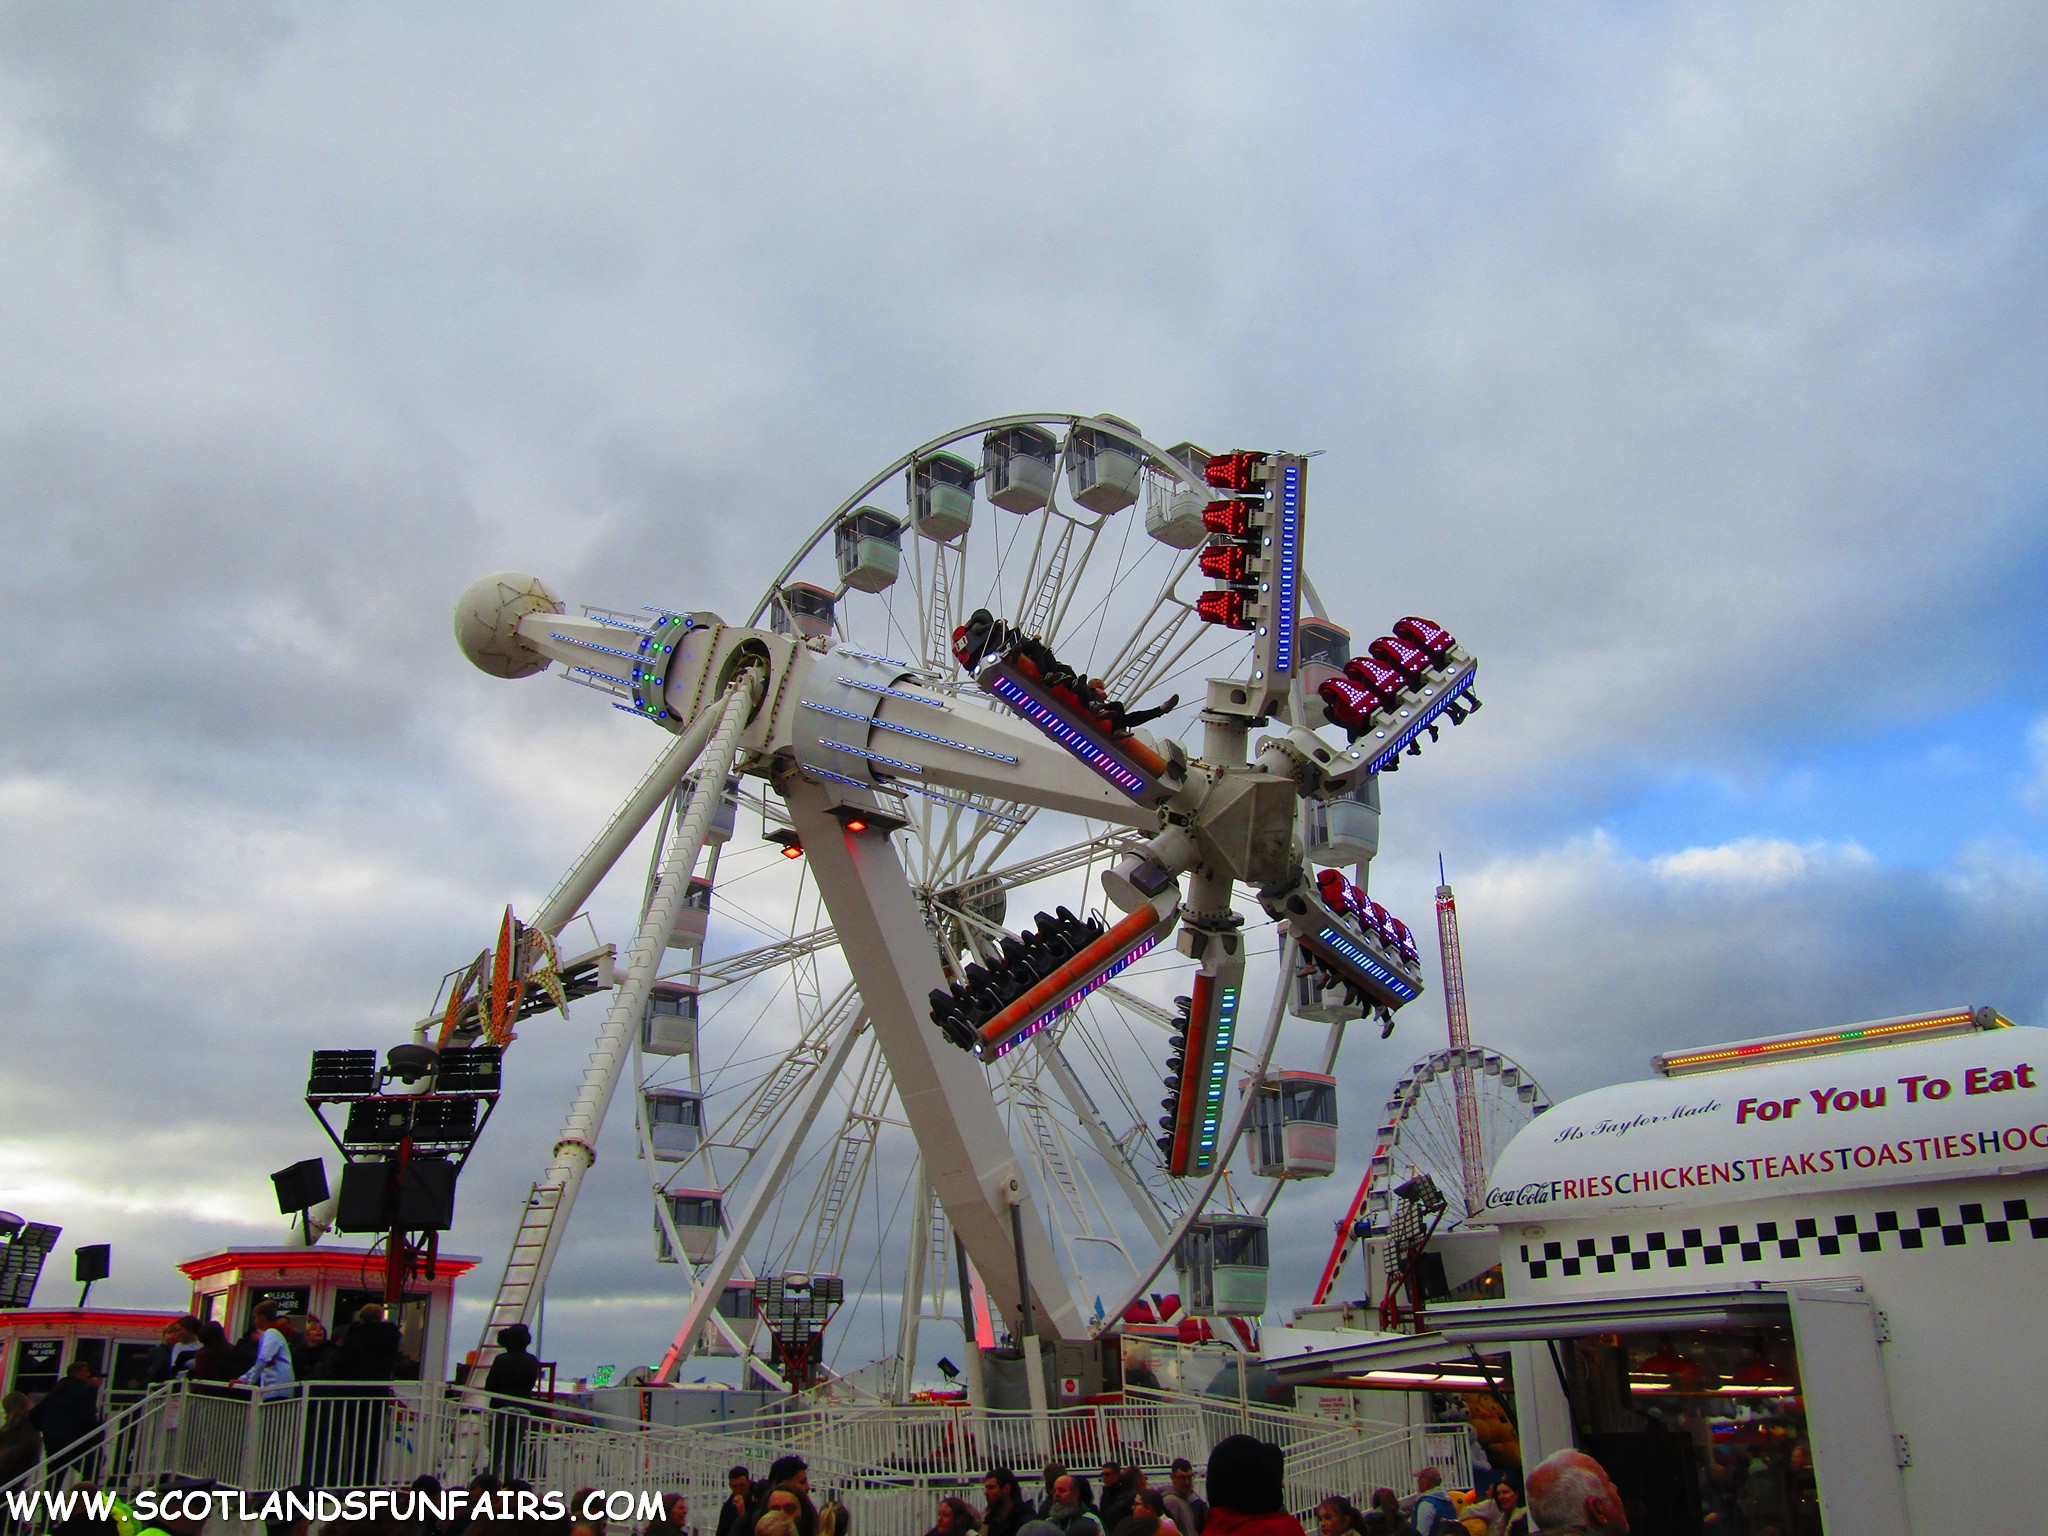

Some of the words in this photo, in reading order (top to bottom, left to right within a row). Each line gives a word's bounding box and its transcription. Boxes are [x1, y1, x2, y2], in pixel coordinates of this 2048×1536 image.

[1554, 1126, 1587, 1144] Its
[1591, 1114, 1661, 1138] Taylor
[1663, 1099, 1723, 1121] Made
[1736, 1098, 1801, 1125] For
[1810, 1086, 1886, 1115] You
[1898, 1075, 1951, 1103] To
[1964, 1063, 2036, 1096] Eat
[267, 1291, 296, 1300] PLEASE
[278, 1300, 300, 1309] HERE
